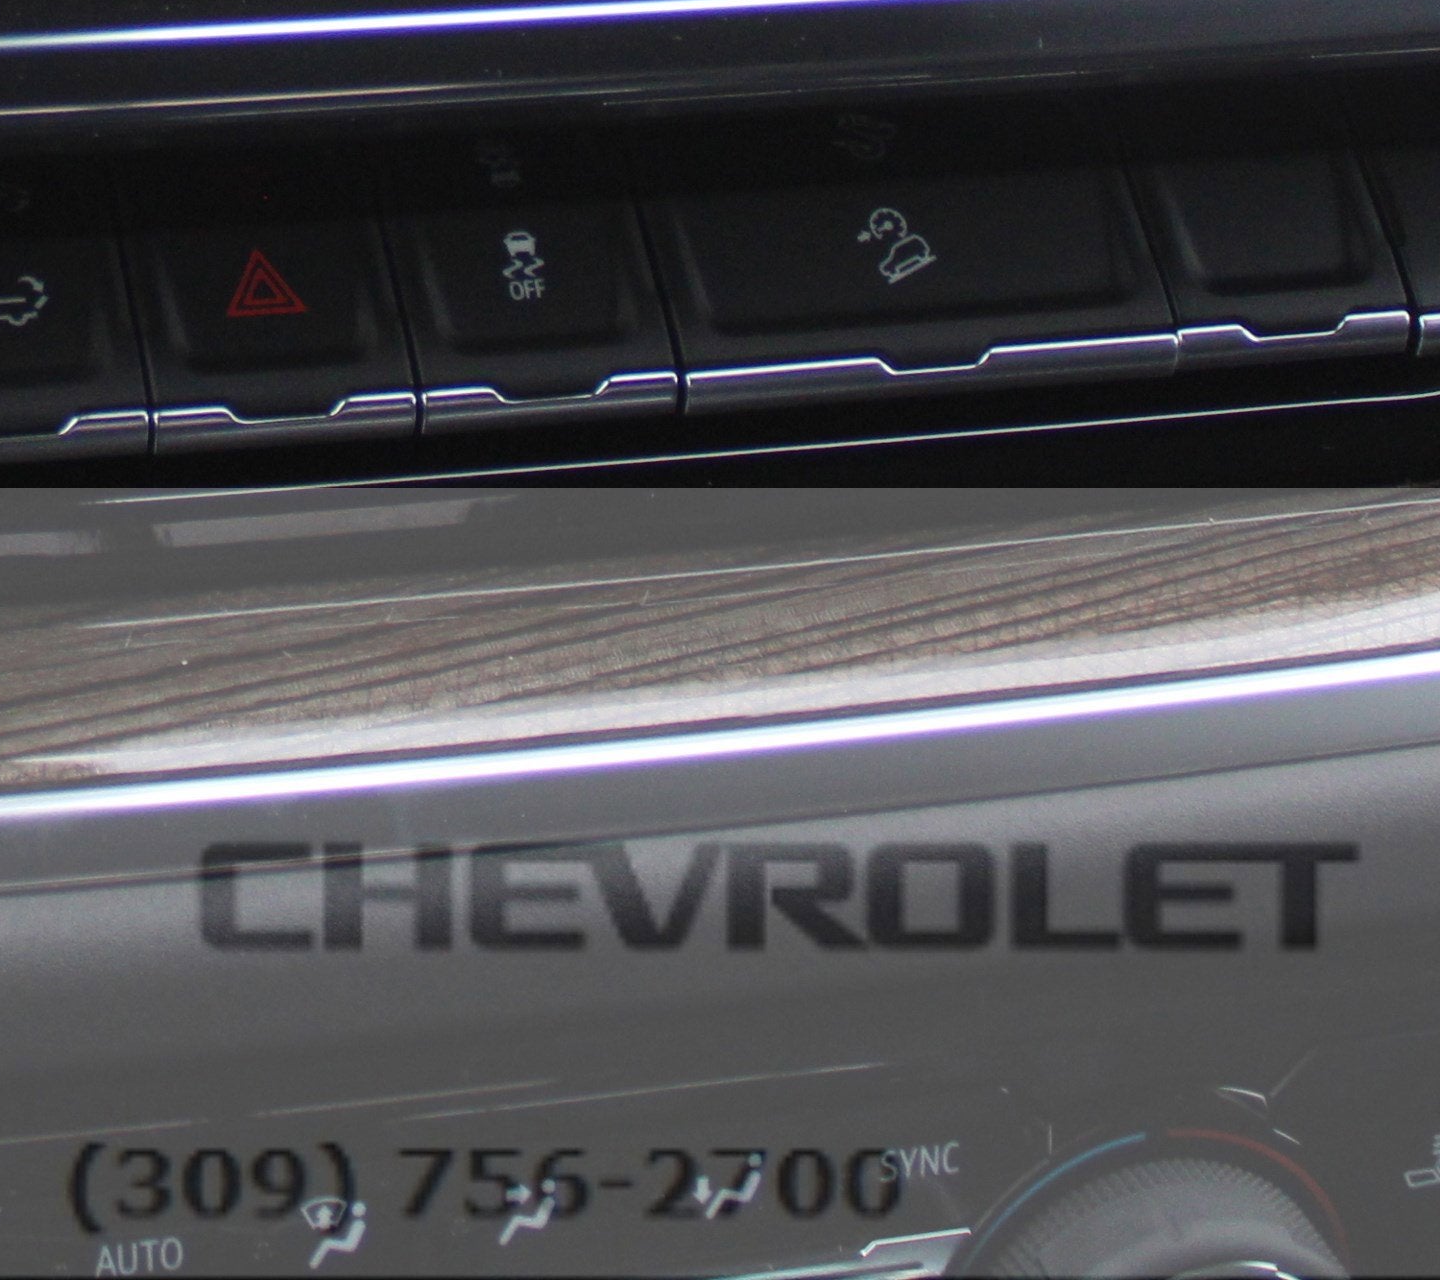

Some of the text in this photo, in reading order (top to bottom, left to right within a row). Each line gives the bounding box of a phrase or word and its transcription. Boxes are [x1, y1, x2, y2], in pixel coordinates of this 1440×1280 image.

[509, 279, 545, 300] OFF
[880, 1140, 959, 1182] SYNC
[96, 1236, 183, 1276] AUTO
